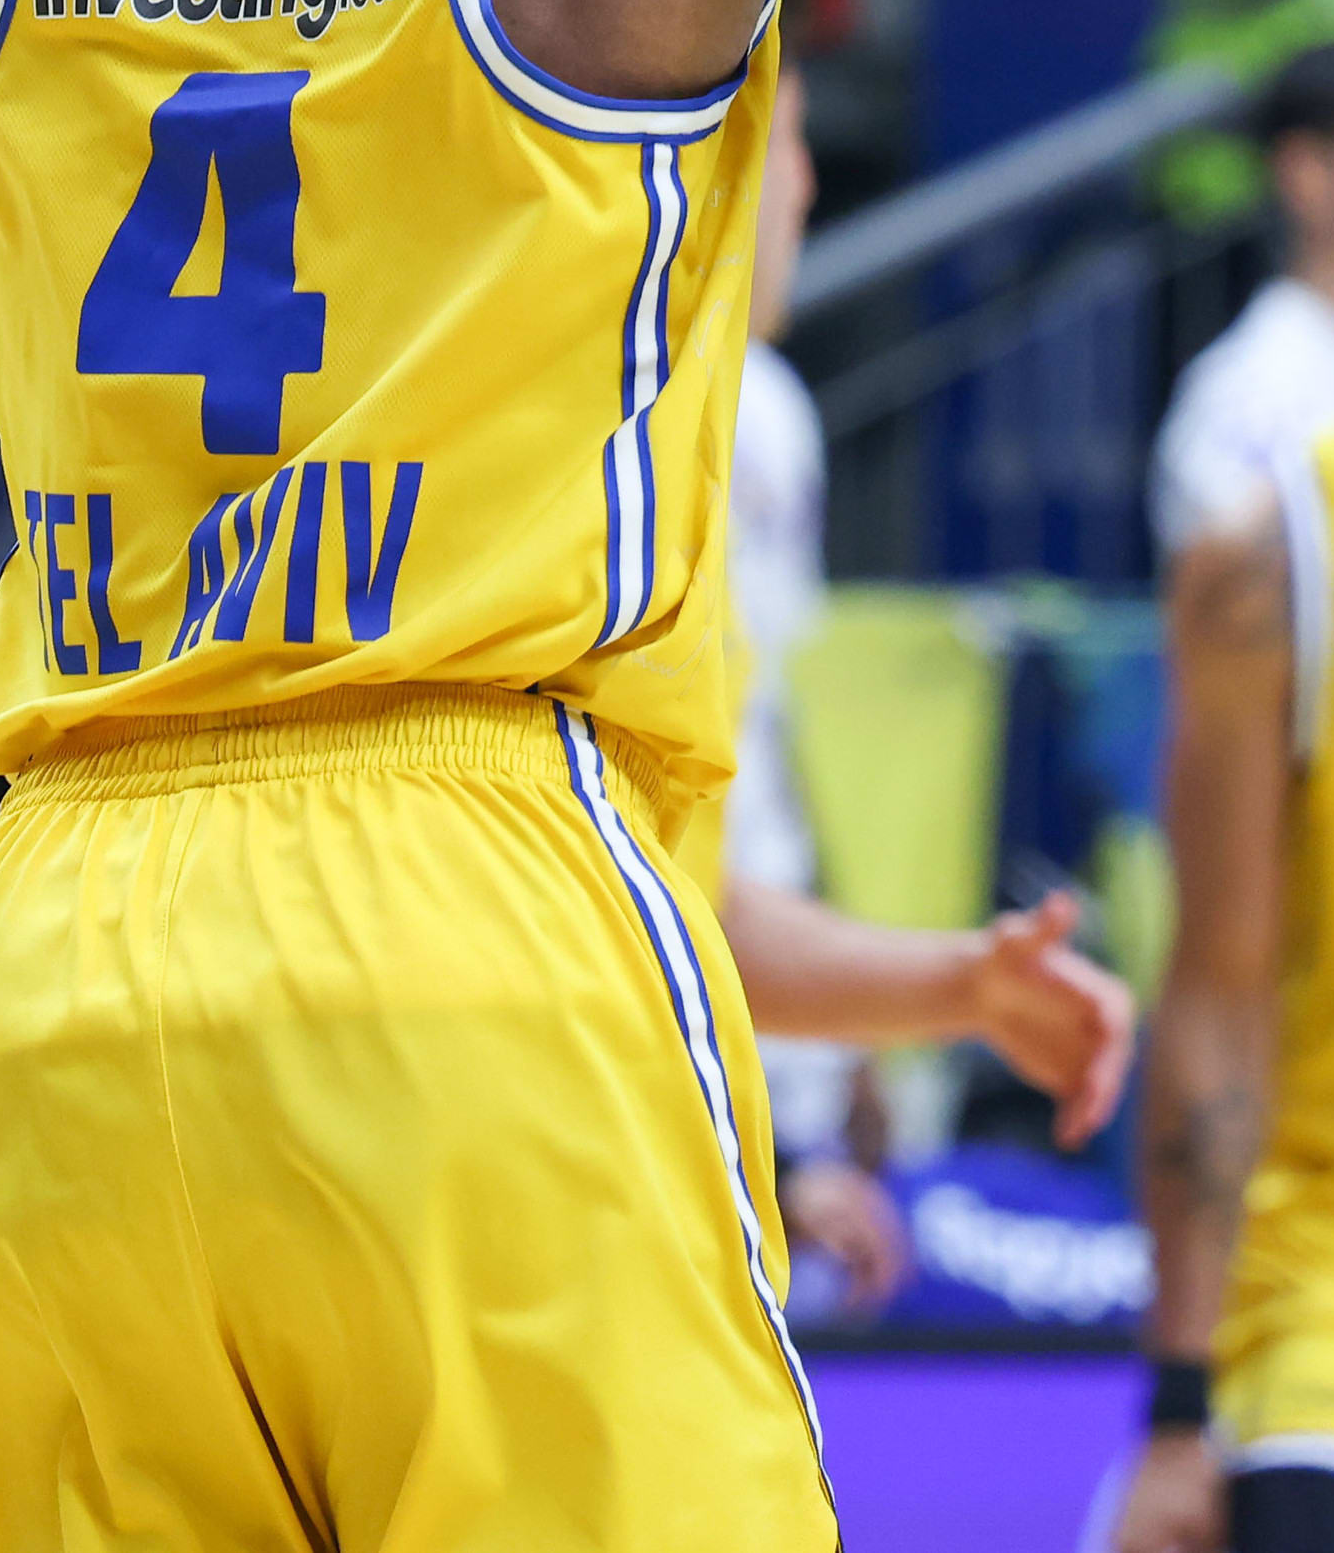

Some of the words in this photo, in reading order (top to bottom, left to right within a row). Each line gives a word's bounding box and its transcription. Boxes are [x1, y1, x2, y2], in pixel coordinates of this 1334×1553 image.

[76, 70, 325, 455] 4
[24, 490, 142, 675] TEL
[167, 461, 424, 661] AVIV
